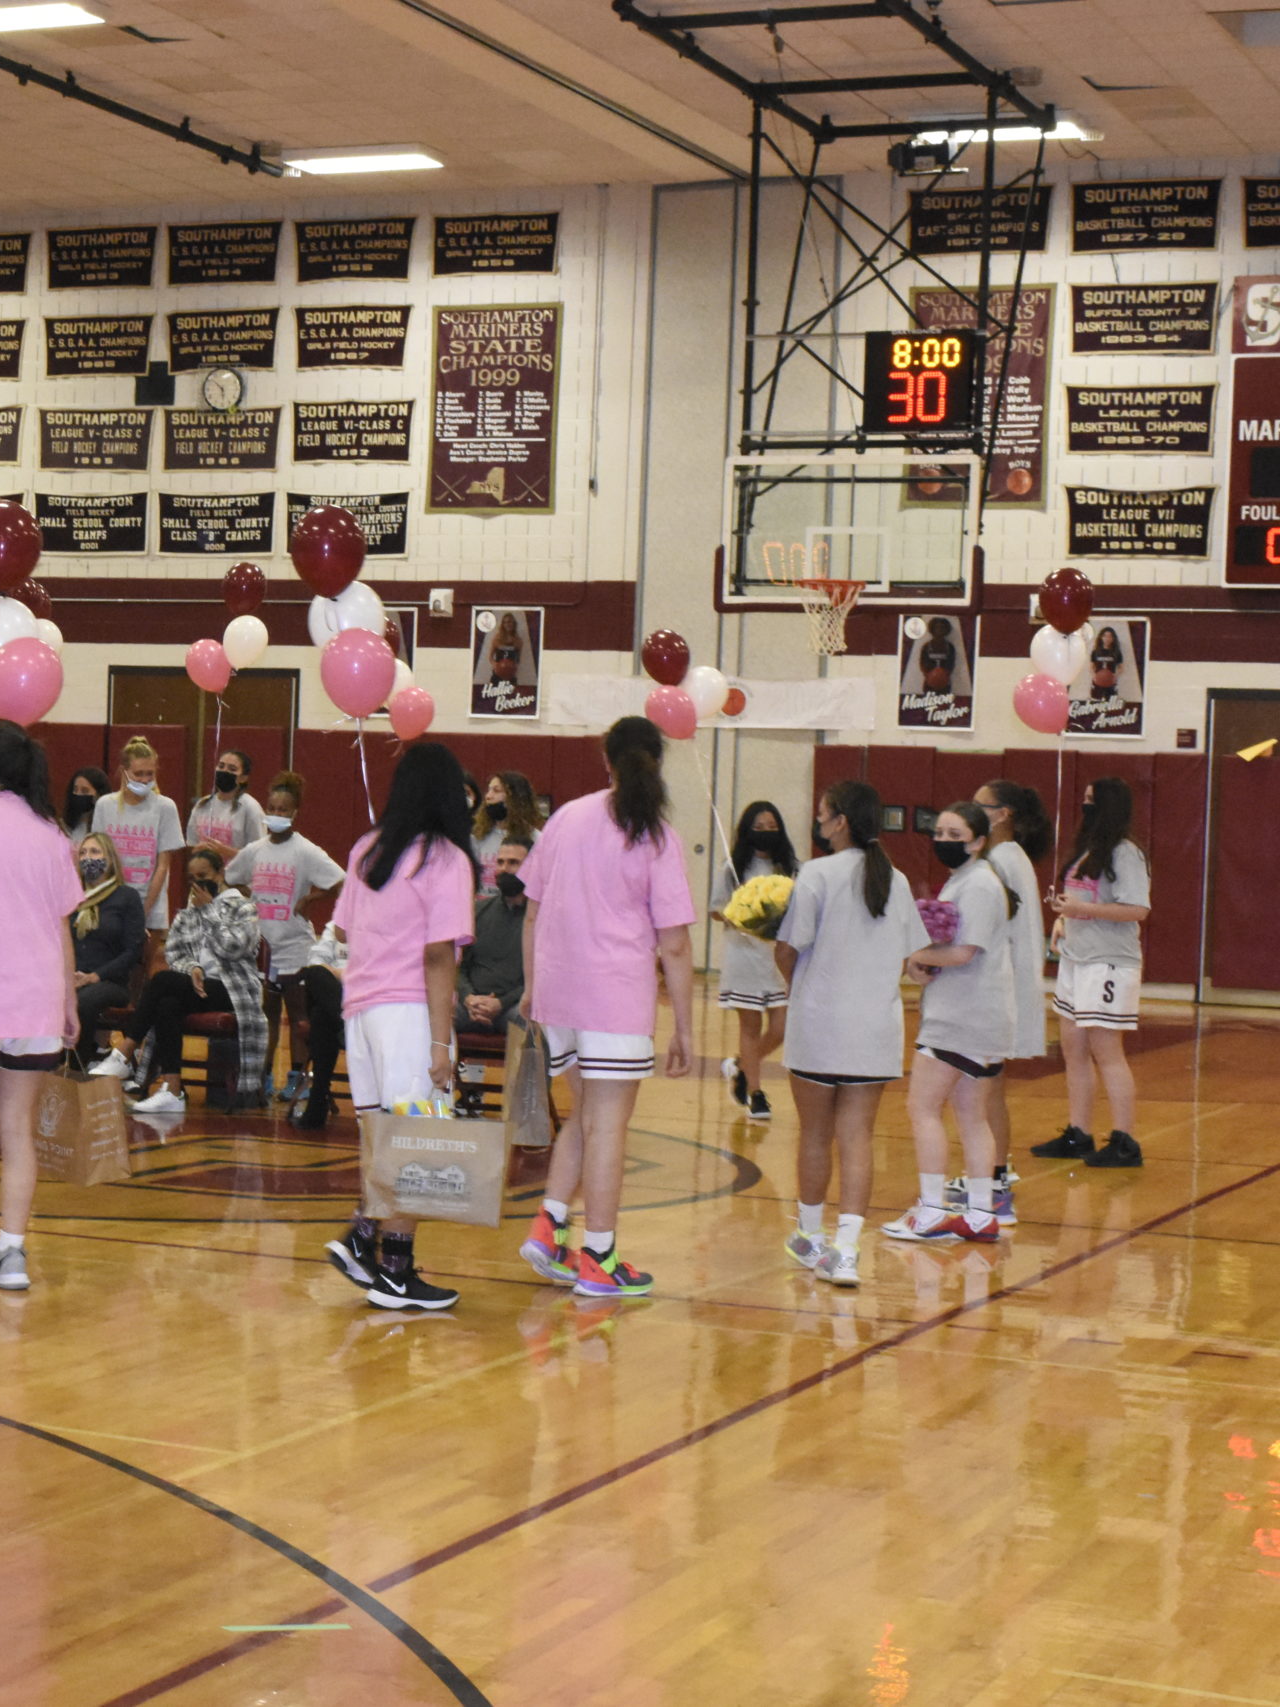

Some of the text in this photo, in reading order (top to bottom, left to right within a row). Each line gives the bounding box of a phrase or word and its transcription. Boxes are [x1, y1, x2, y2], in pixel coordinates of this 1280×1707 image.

[1085, 186, 1208, 203] SOUTHAMPTON
[1111, 205, 1179, 213] SECTION
[305, 223, 405, 238] SOUTHAMPTON
[445, 220, 548, 234] SOUTHAMPTON
[1077, 217, 1213, 231] BASKETBALL CHAMPIONS
[56, 232, 148, 247] SOUTHAMPTON
[177, 229, 271, 242] SOUTHAMPTON
[103, 248, 151, 258] CHAMPIONS
[226, 243, 275, 253] CHAMPIONS
[1083, 289, 1206, 304] SOUTHAMPTON
[304, 312, 401, 325] SOUTHAMPTON
[441, 310, 553, 325] SOUTHAMPTON
[1085, 309, 1133, 317] SUFFOLK
[1137, 308, 1180, 316] COUNTY
[54, 321, 144, 335] SOUTHAMPTON
[176, 315, 269, 329] SOUTHAMPTON
[1076, 320, 1209, 332] BASKETBALL CHAMPIONS
[353, 328, 404, 338] CHAMPIONS
[449, 323, 544, 338] MARINERS
[449, 340, 542, 354] STATE
[893, 338, 961, 369] 8:00
[439, 355, 553, 373] CHAMPIONS
[471, 369, 520, 387] 1999
[887, 371, 946, 422] 30
[1078, 392, 1202, 405] SOUTHAMPTON
[299, 404, 408, 418] SOUTHAMPTON
[1007, 404, 1042, 412] Madison
[47, 413, 146, 424] SOUTHAMPTON
[172, 412, 273, 424] SOUTHAMPTON
[51, 428, 83, 438] LEAGUE
[302, 421, 338, 431] LEAGUE
[1072, 422, 1207, 432] BASKETBALL CHAMPIONS
[174, 429, 208, 438] LEAGUE
[297, 433, 406, 446] FIELD HOCKEY CHAMPIONS
[48, 497, 133, 507] SOUTHAMPTON
[173, 497, 259, 507] SOUTHAMPTON
[1075, 491, 1205, 505] SOUTHAMPTON
[1103, 510, 1149, 519] LEAGUE
[109, 518, 142, 527] COUNTY
[163, 518, 269, 528] SMALL COUNTY
[73, 530, 107, 540] CHAMPS
[171, 530, 260, 540] CLASS CHAMPS
[1075, 523, 1203, 538] BASKETBALL CHAMPIONS
[482, 681, 514, 698] Hallie
[902, 691, 954, 710] Madison
[1068, 696, 1124, 719] Gabriella
[925, 704, 969, 725] Taylor
[1092, 707, 1138, 730] Arnold
[1102, 979, 1115, 1003] S
[391, 1135, 478, 1153] HILDRETH'S
